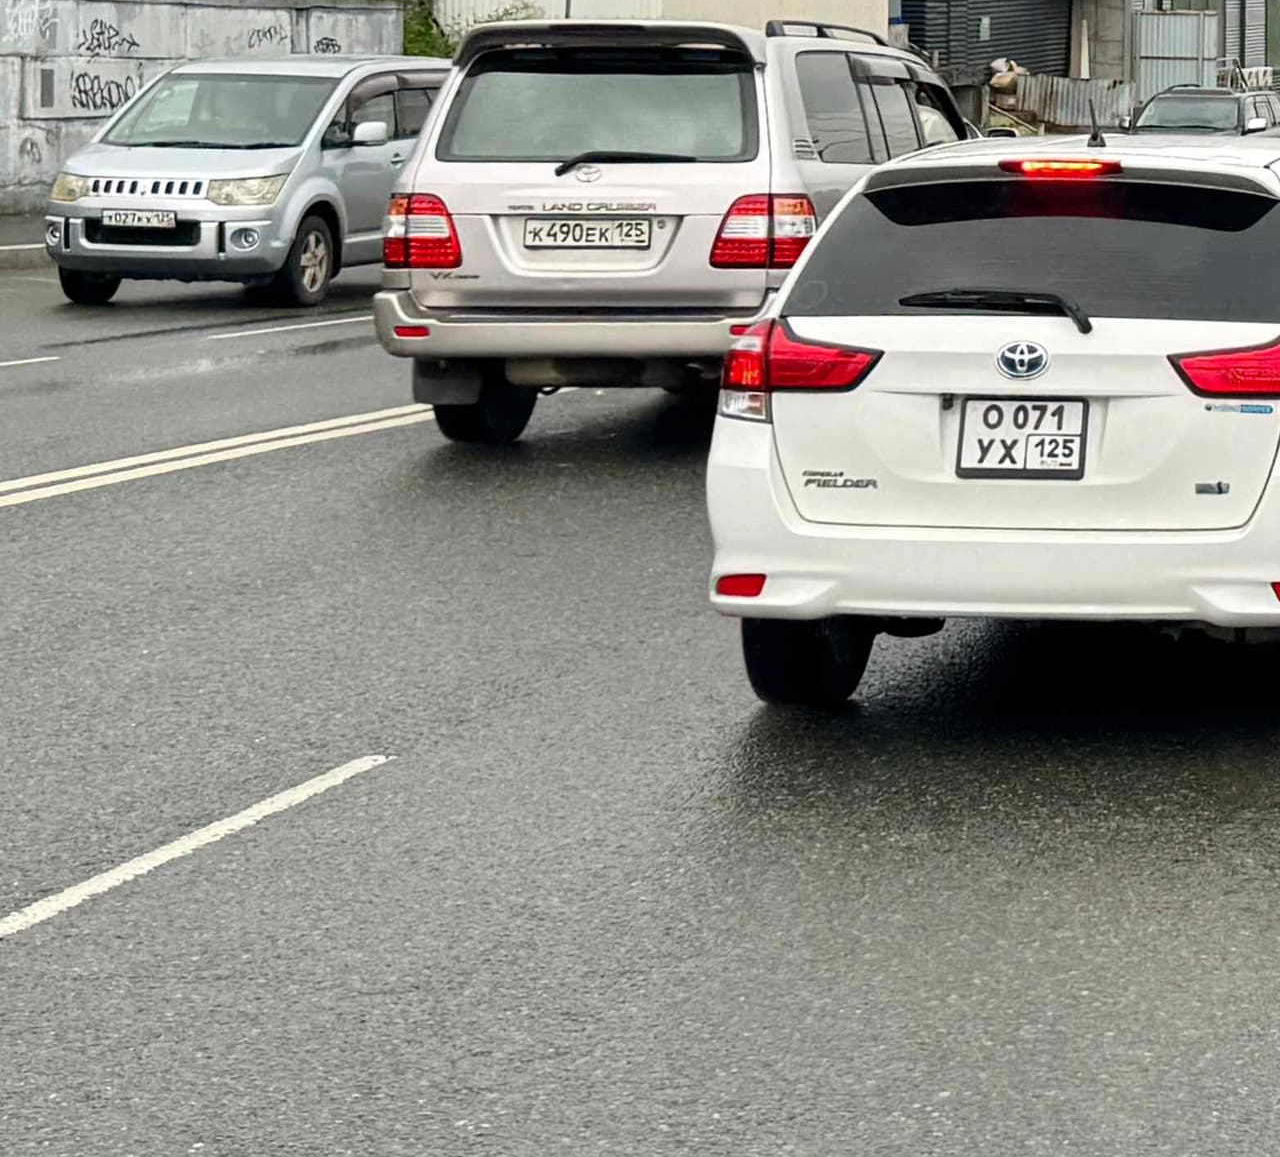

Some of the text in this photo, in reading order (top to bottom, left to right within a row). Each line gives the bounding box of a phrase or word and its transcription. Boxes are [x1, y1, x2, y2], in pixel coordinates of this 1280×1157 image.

[542, 203, 583, 211] LAND
[616, 222, 645, 238] 125
[1013, 404, 1065, 431] 071
[1034, 438, 1075, 458] 125
[803, 478, 878, 489] FIELDER
